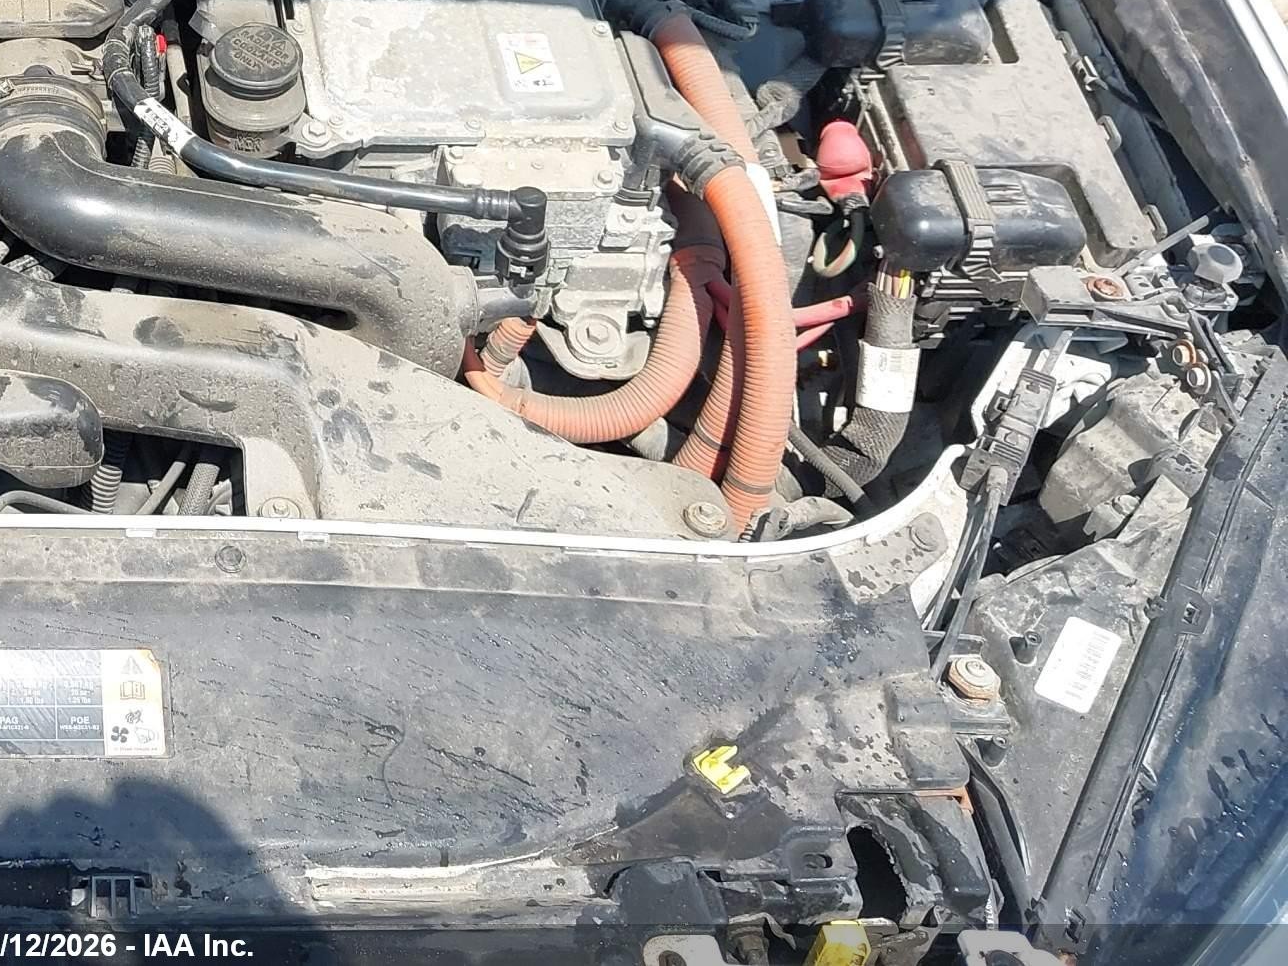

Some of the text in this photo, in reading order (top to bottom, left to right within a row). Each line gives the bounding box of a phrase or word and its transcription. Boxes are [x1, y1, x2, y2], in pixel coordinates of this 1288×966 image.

[233, 38, 280, 68] COOLANT
[233, 52, 258, 69] ONLY
[0, 716, 19, 724] PAG
[71, 716, 90, 724] POE
